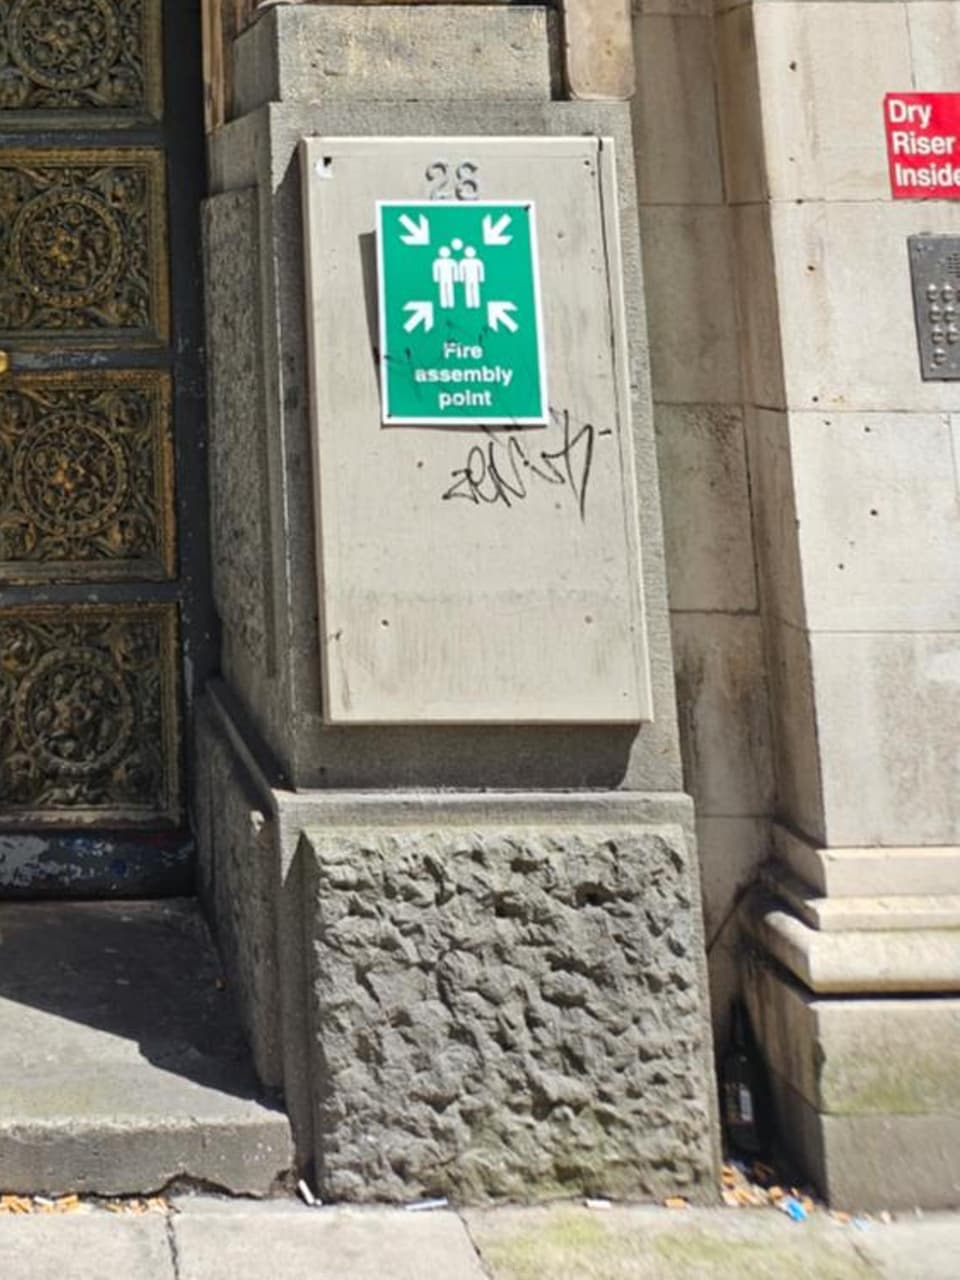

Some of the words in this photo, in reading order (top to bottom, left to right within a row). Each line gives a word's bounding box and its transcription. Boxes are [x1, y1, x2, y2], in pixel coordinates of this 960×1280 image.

[888, 100, 932, 128] Dry
[892, 131, 957, 155] Riser
[444, 342, 483, 359] Fire
[414, 366, 513, 386] assembly
[438, 390, 492, 410] point
